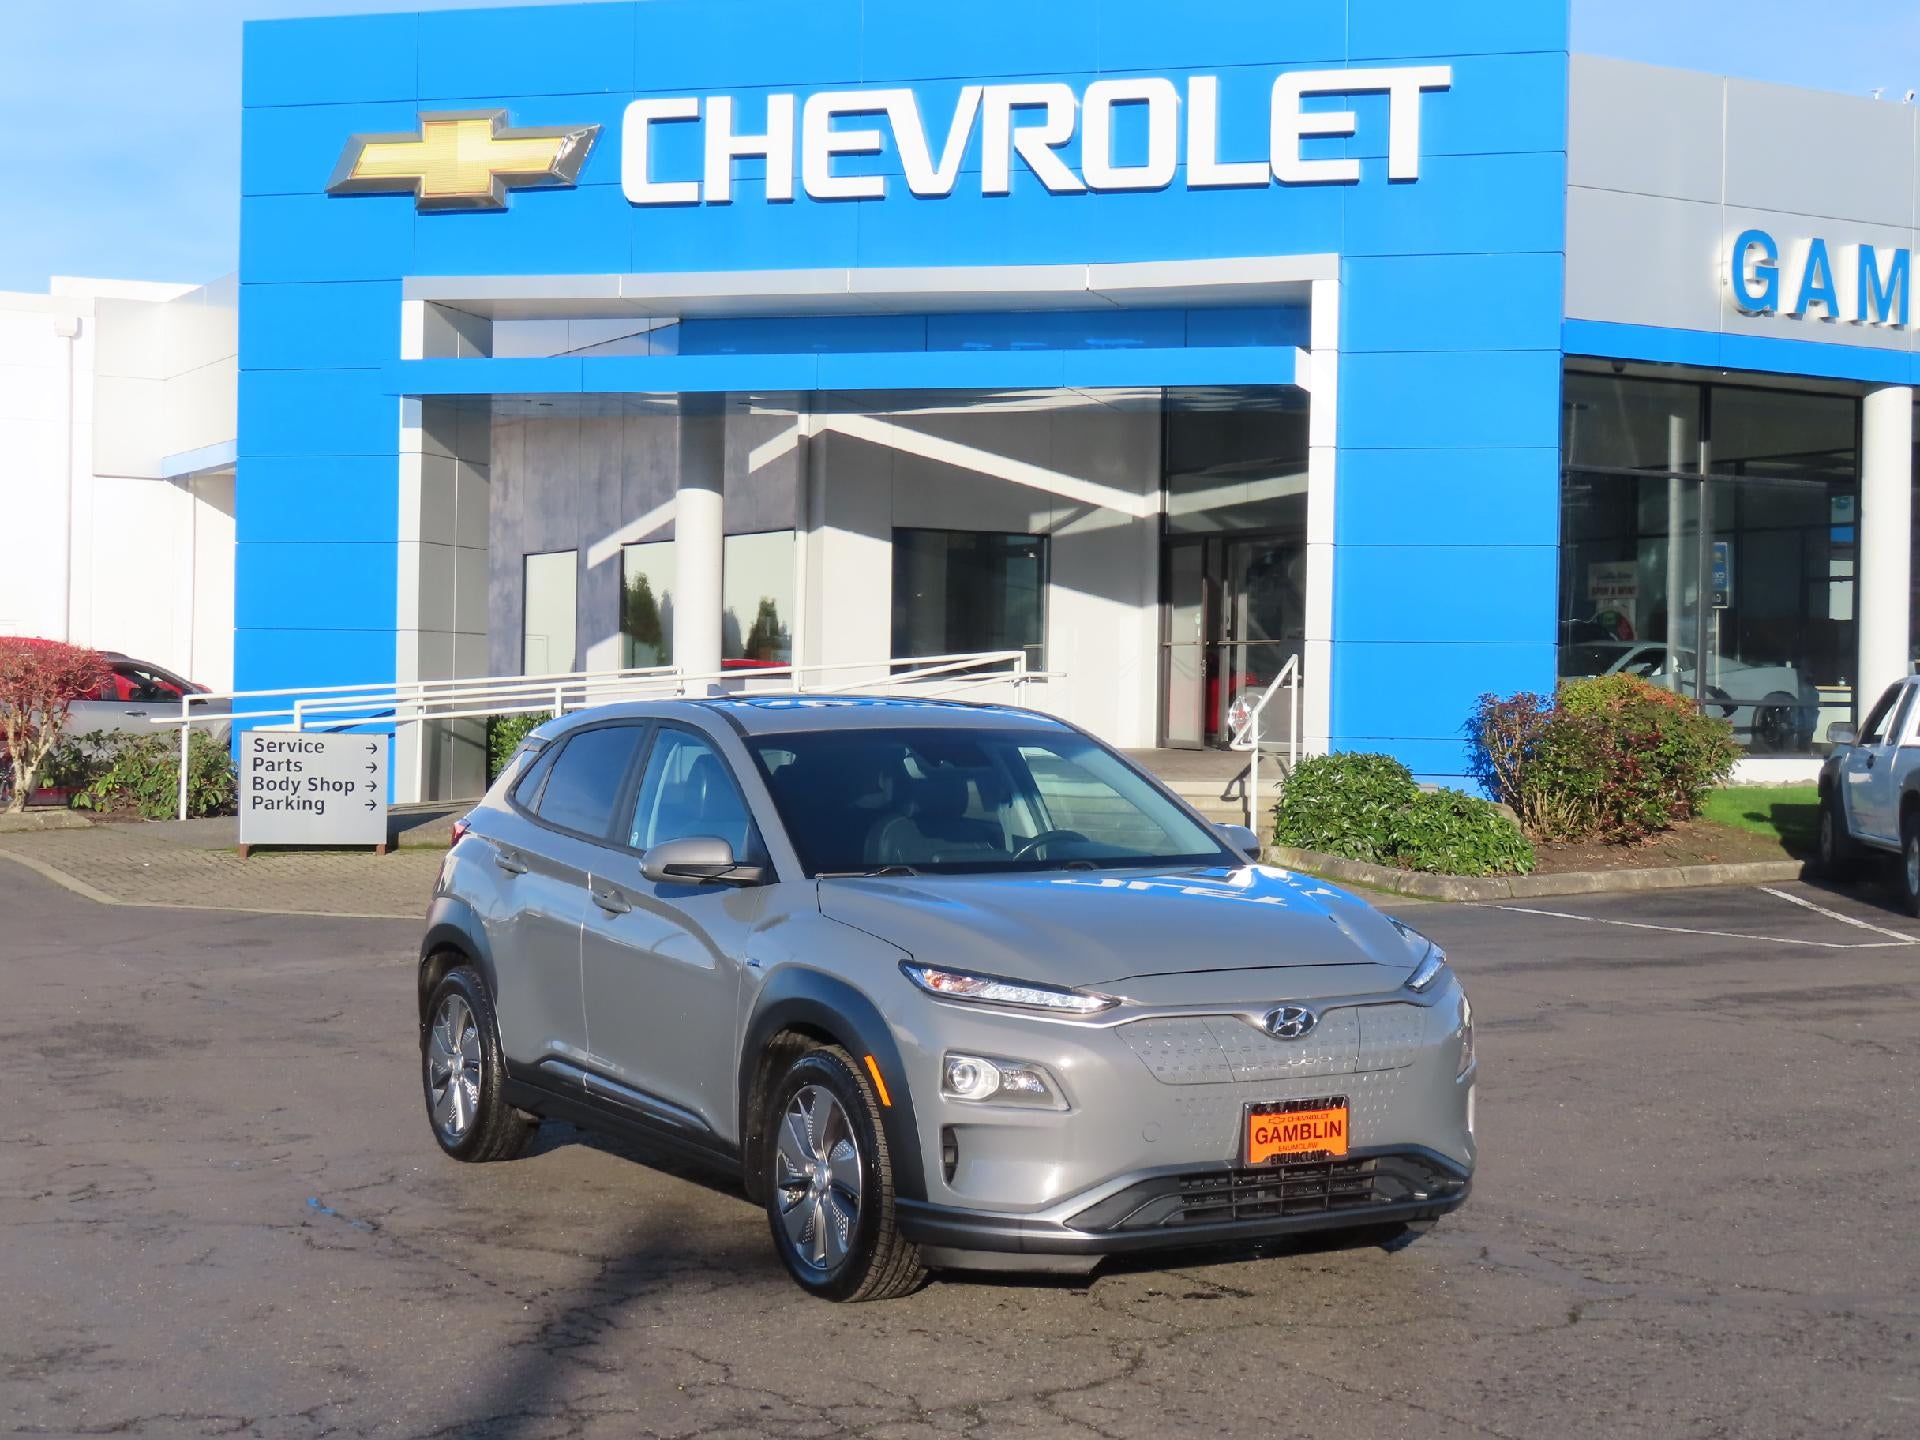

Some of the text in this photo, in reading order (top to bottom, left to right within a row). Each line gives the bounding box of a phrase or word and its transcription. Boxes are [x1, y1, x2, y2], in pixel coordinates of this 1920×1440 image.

[620, 65, 1453, 206] CHEVROLET
[1730, 228, 1918, 328] GAM
[253, 737, 325, 754] Service
[252, 756, 303, 773] Parts
[252, 776, 356, 797] Body Shop
[252, 795, 325, 816] Parking
[1254, 1120, 1342, 1145] GAMBLIN
